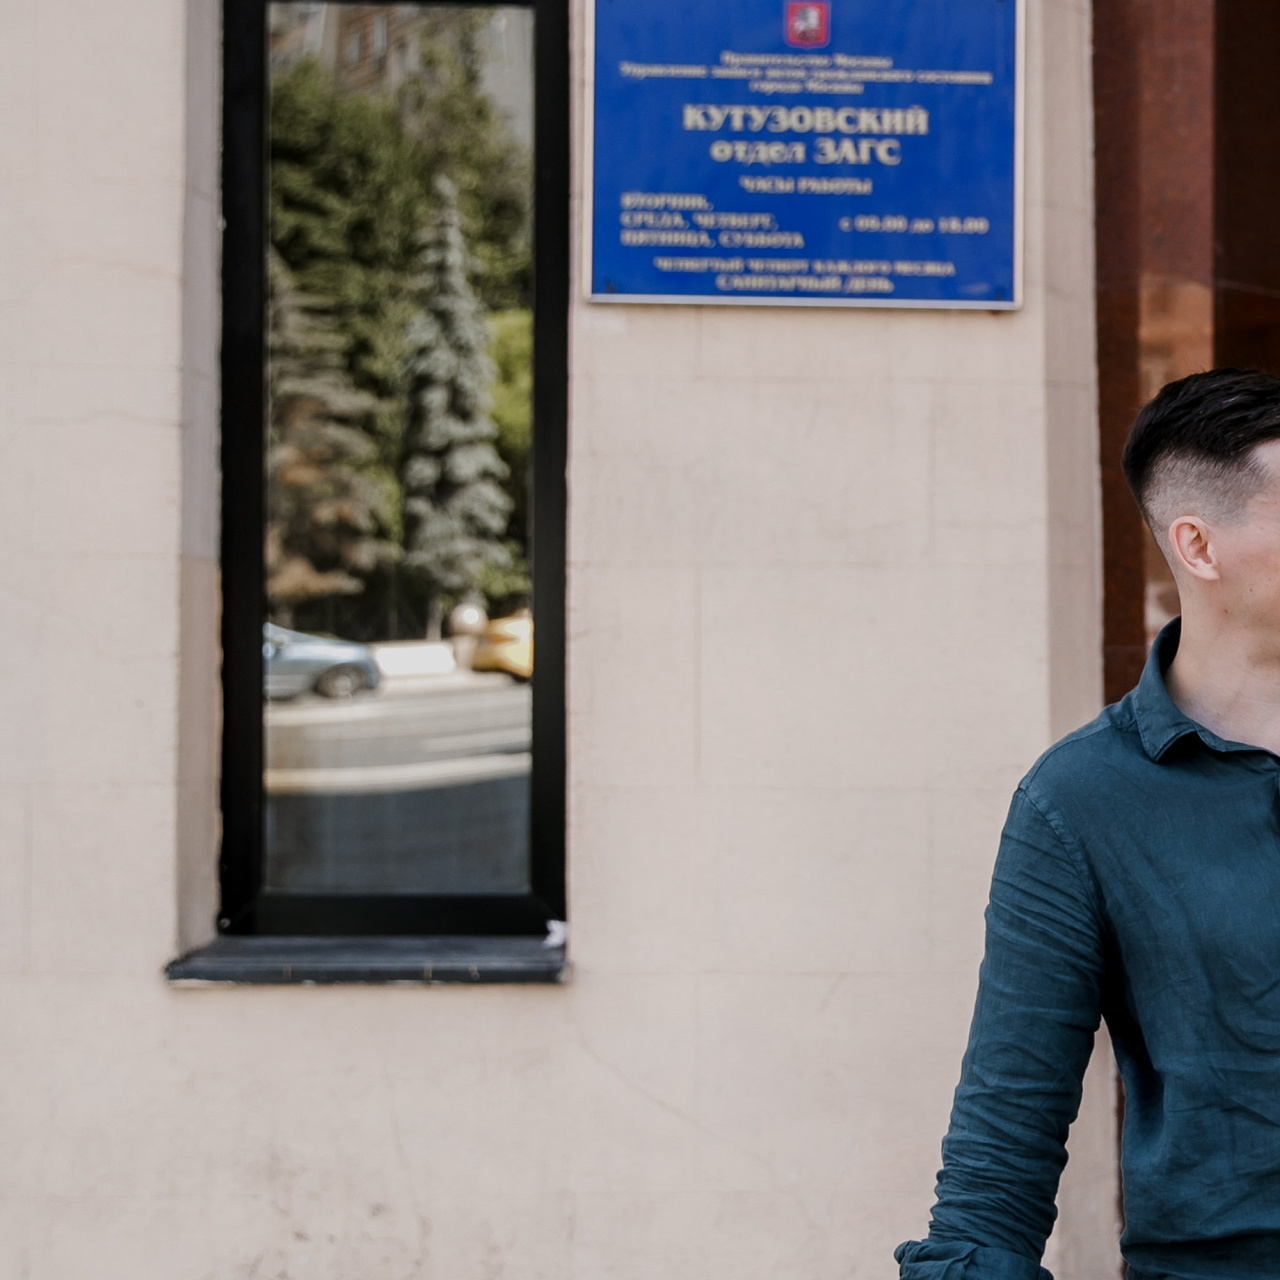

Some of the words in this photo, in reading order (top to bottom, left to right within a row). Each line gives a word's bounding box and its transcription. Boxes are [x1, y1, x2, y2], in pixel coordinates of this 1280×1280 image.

[682, 103, 929, 136] КУТУЗОВСКИЙ
[709, 138, 806, 168] отдел
[813, 136, 902, 166] ЗАГС
